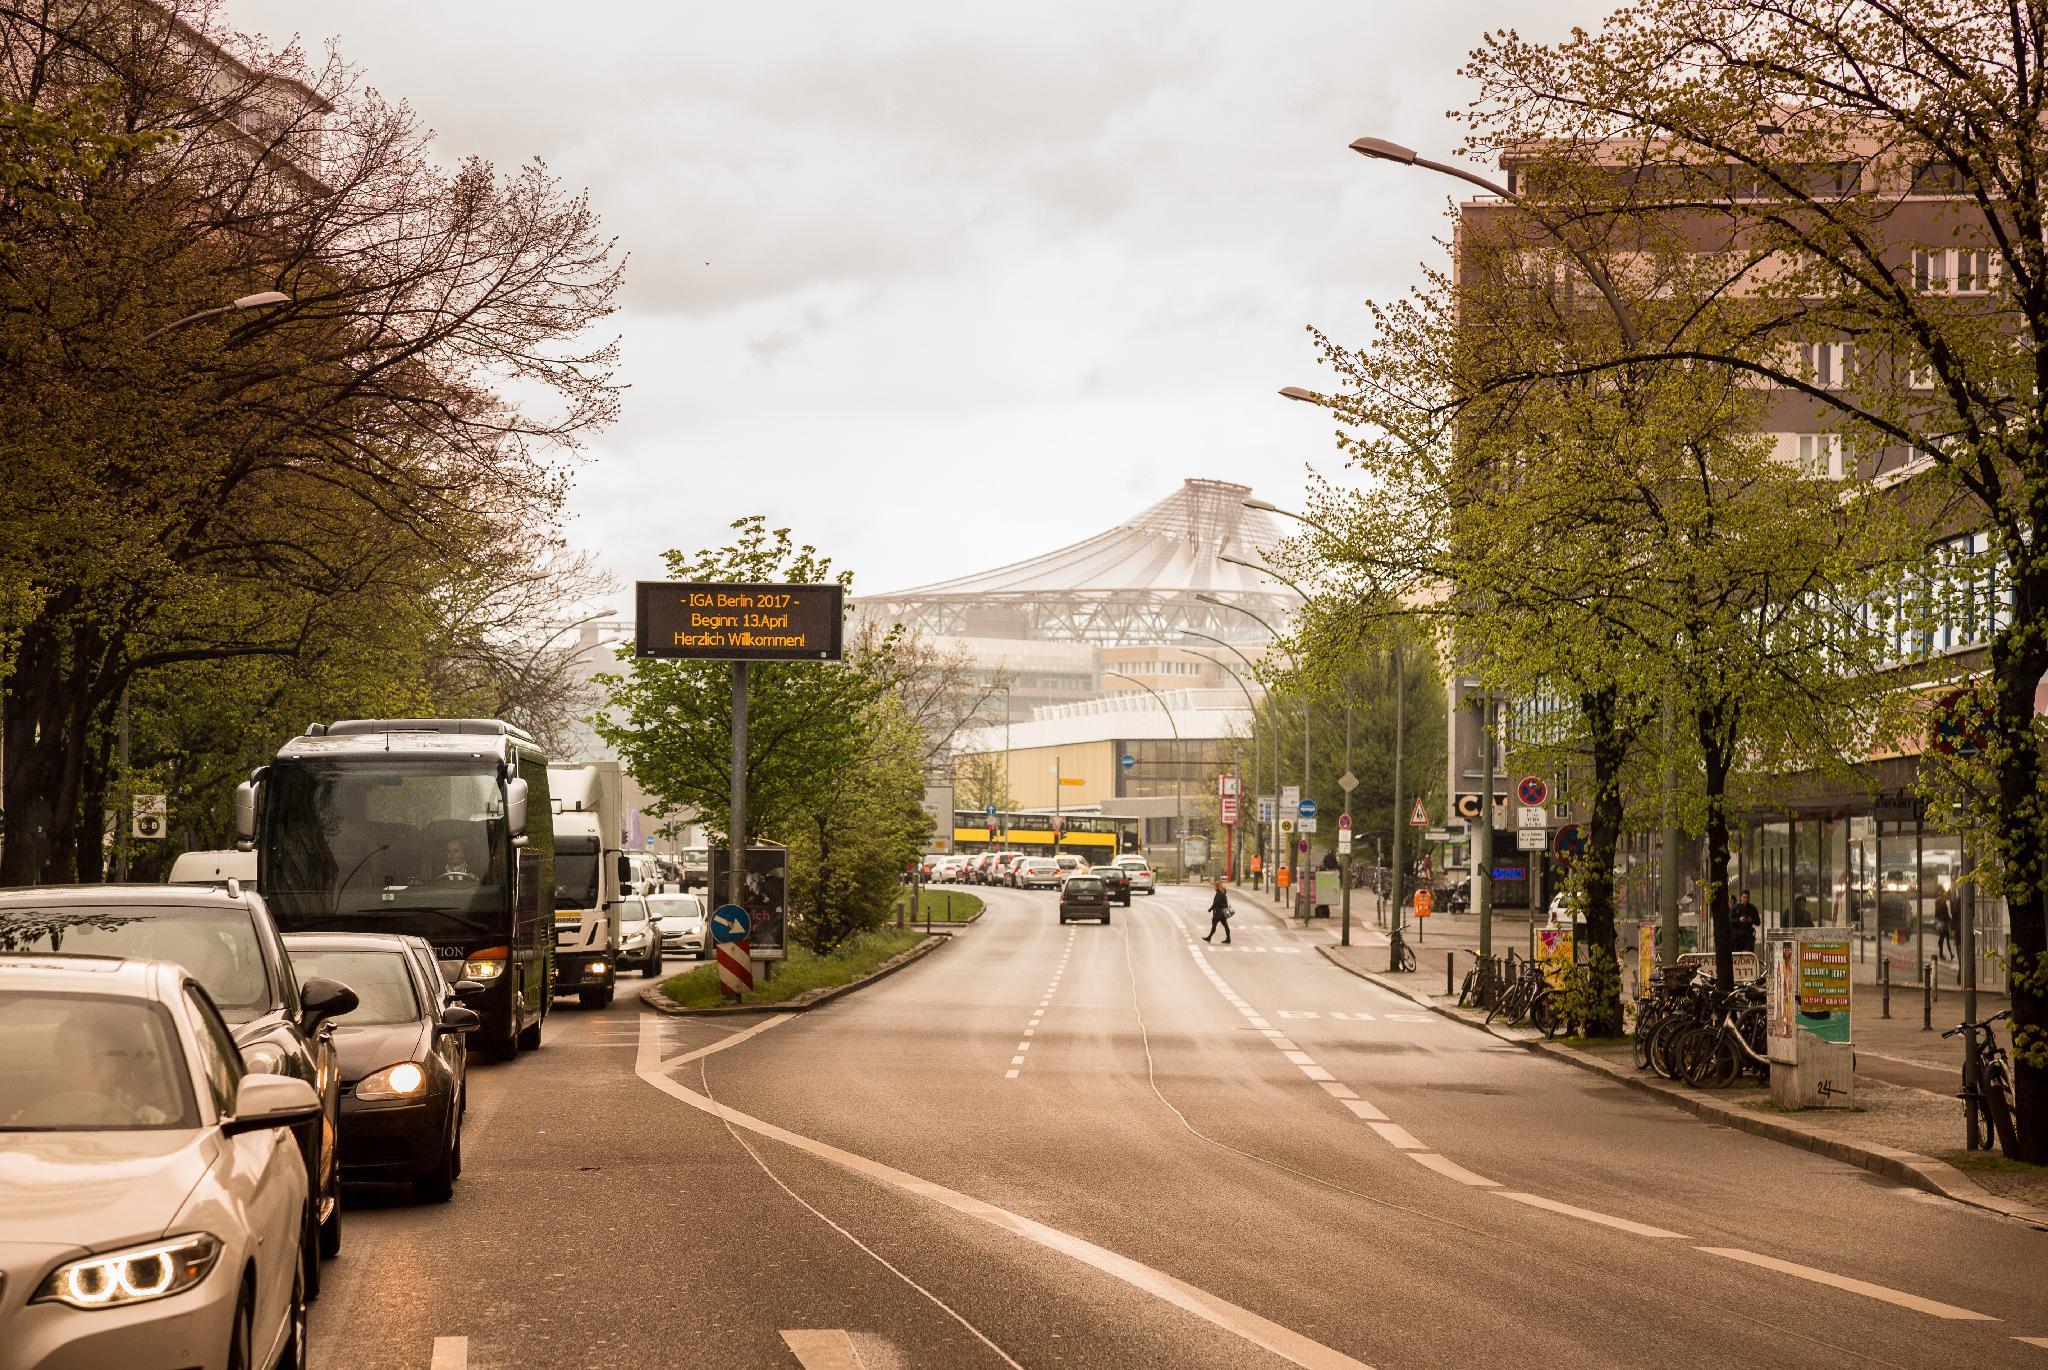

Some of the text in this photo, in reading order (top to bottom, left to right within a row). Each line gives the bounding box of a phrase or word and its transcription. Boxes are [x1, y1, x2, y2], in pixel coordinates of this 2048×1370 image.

[689, 594, 713, 607] IGA
[718, 594, 753, 607] Berlin
[758, 595, 790, 608] 2017
[692, 614, 788, 629] Beginn: 13.April
[675, 632, 805, 647] Herzlich Willkommen!
[1491, 869, 1523, 879] ASINO
[433, 946, 464, 957] TION
